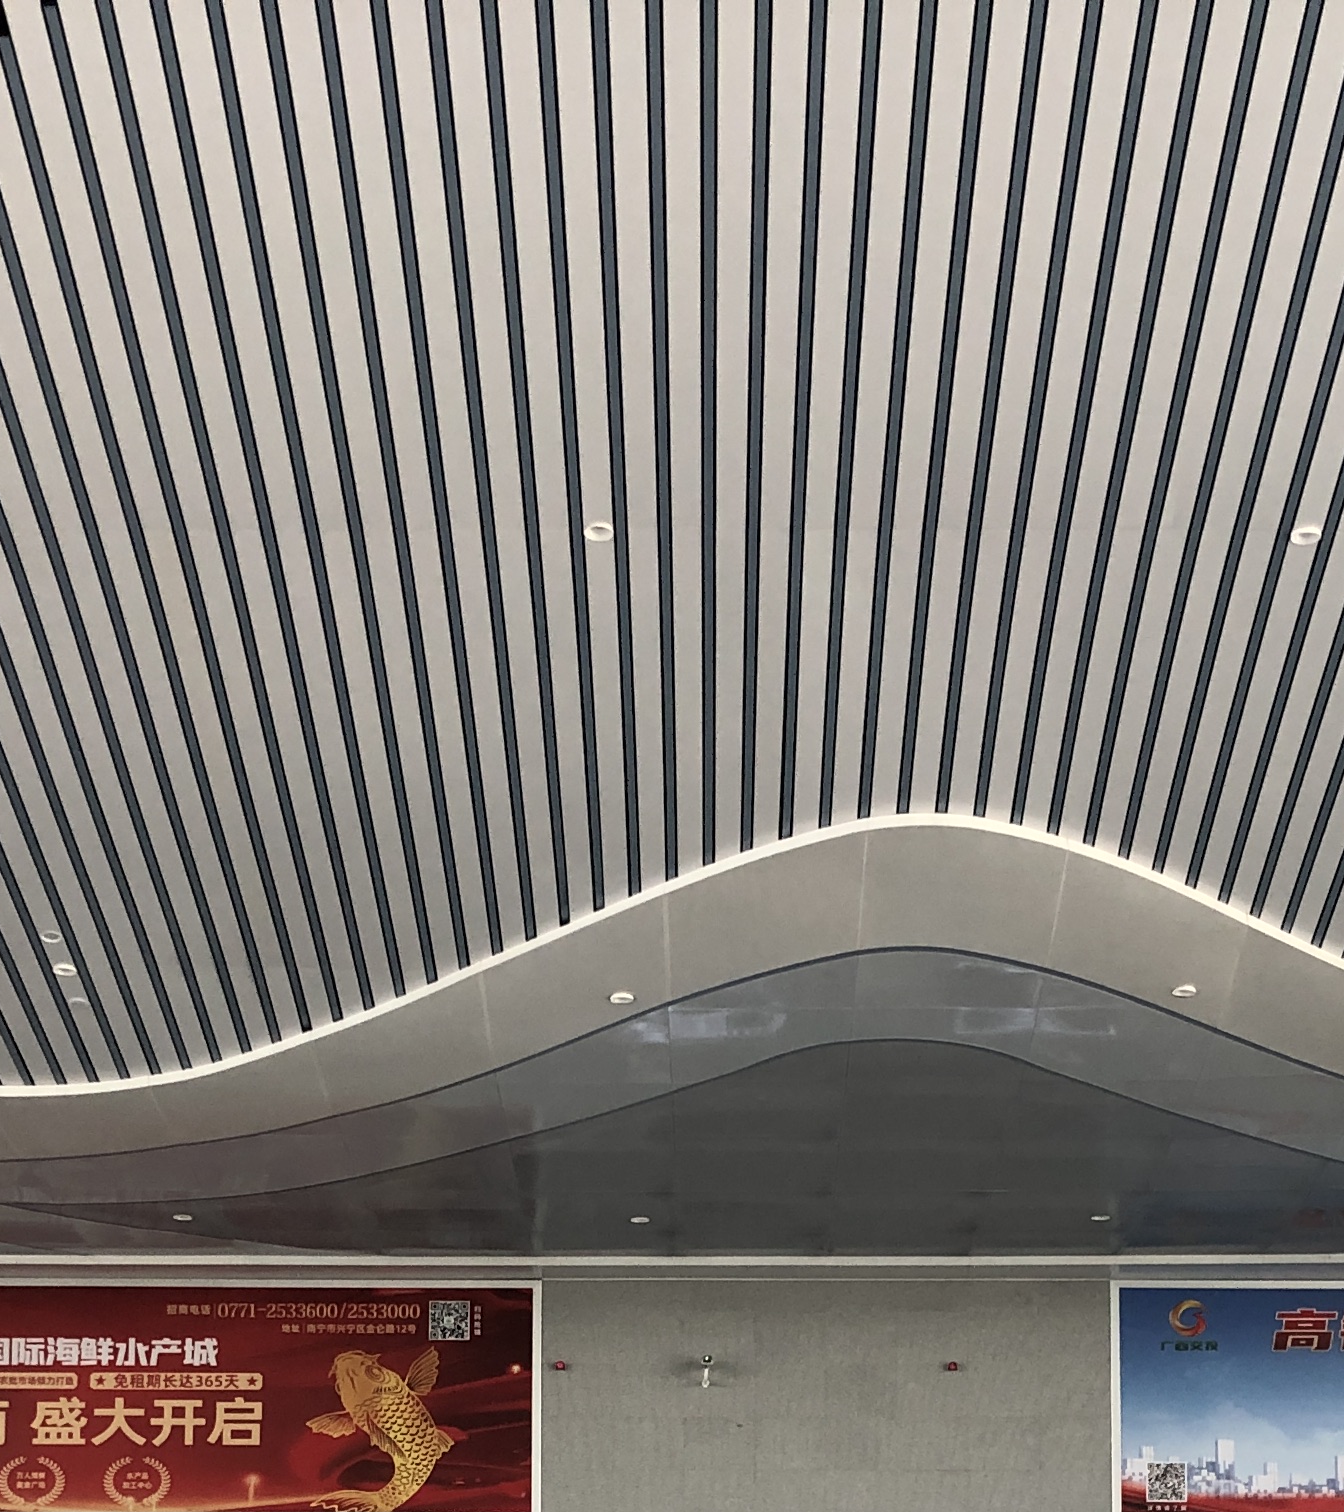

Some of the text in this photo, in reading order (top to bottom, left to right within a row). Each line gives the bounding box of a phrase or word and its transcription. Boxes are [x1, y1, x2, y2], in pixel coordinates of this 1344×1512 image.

[217, 1302, 420, 1319] 0771-2533600/2533000
[113, 1374, 240, 1389] 免租期长达365天
[30, 1397, 264, 1447] 盛大开启
